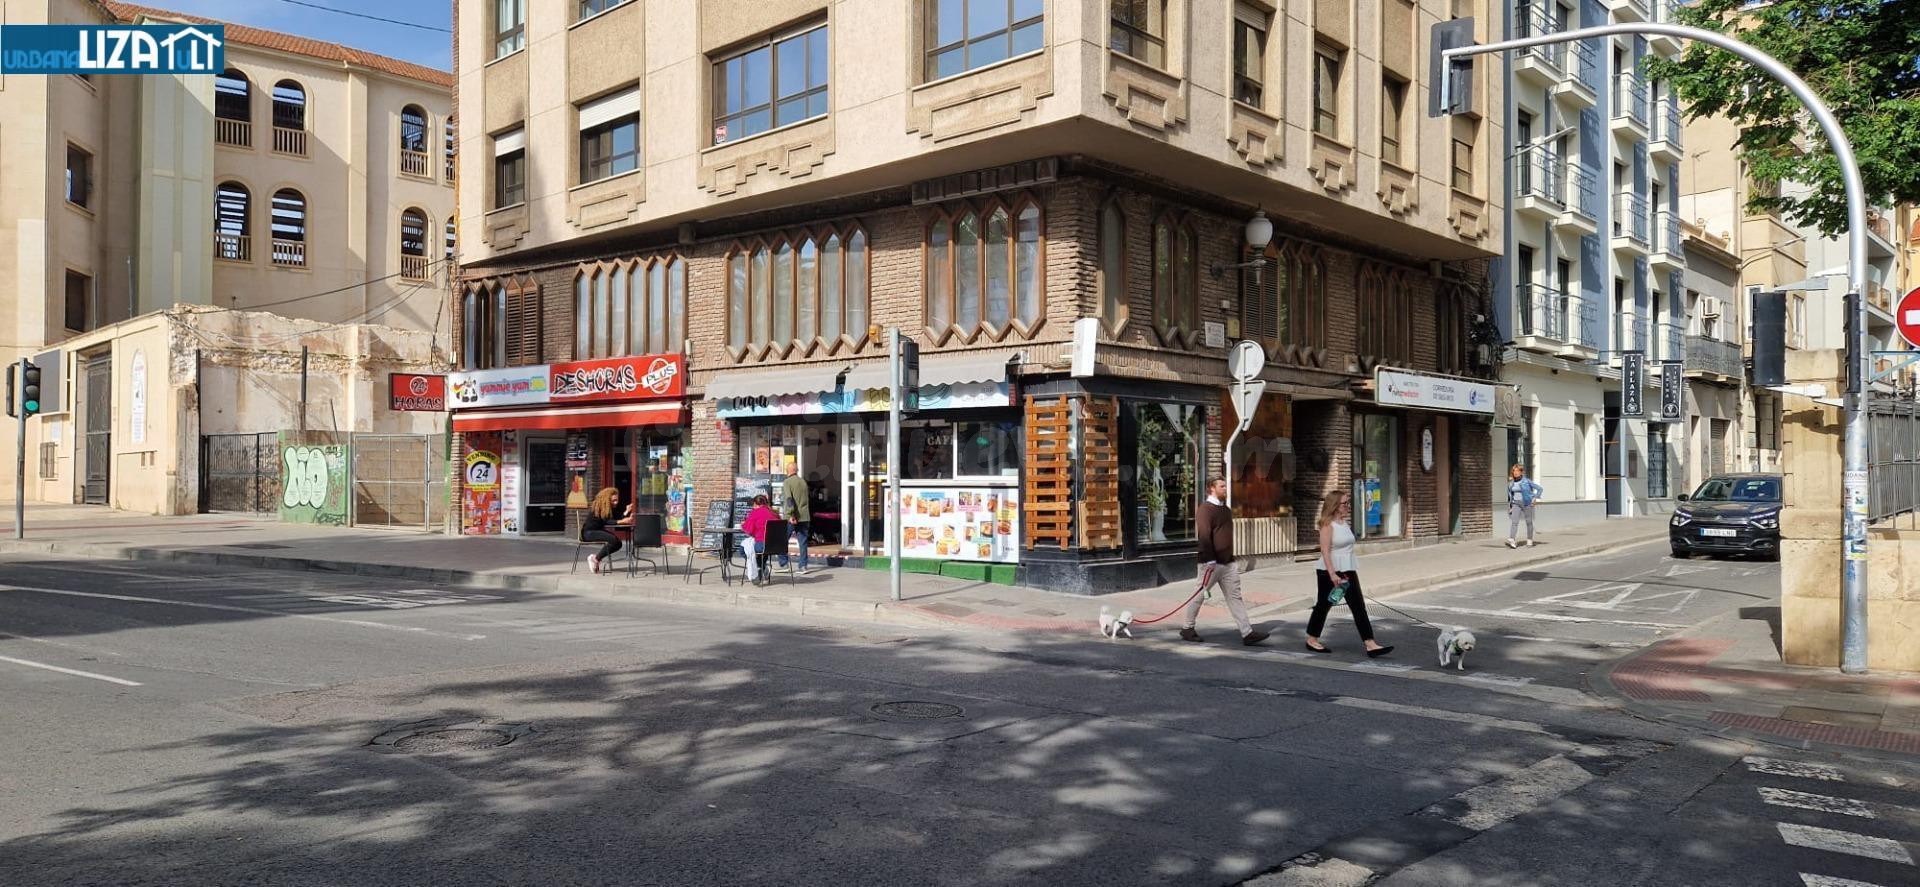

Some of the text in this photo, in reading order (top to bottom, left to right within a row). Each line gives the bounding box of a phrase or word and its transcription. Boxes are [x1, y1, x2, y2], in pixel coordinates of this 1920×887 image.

[1629, 355, 1636, 368] LA
[411, 379, 427, 393] 24
[552, 364, 637, 395] DESHORAS
[645, 364, 676, 385] PLUS
[394, 396, 443, 410] HORAS
[475, 468, 489, 479] 24
